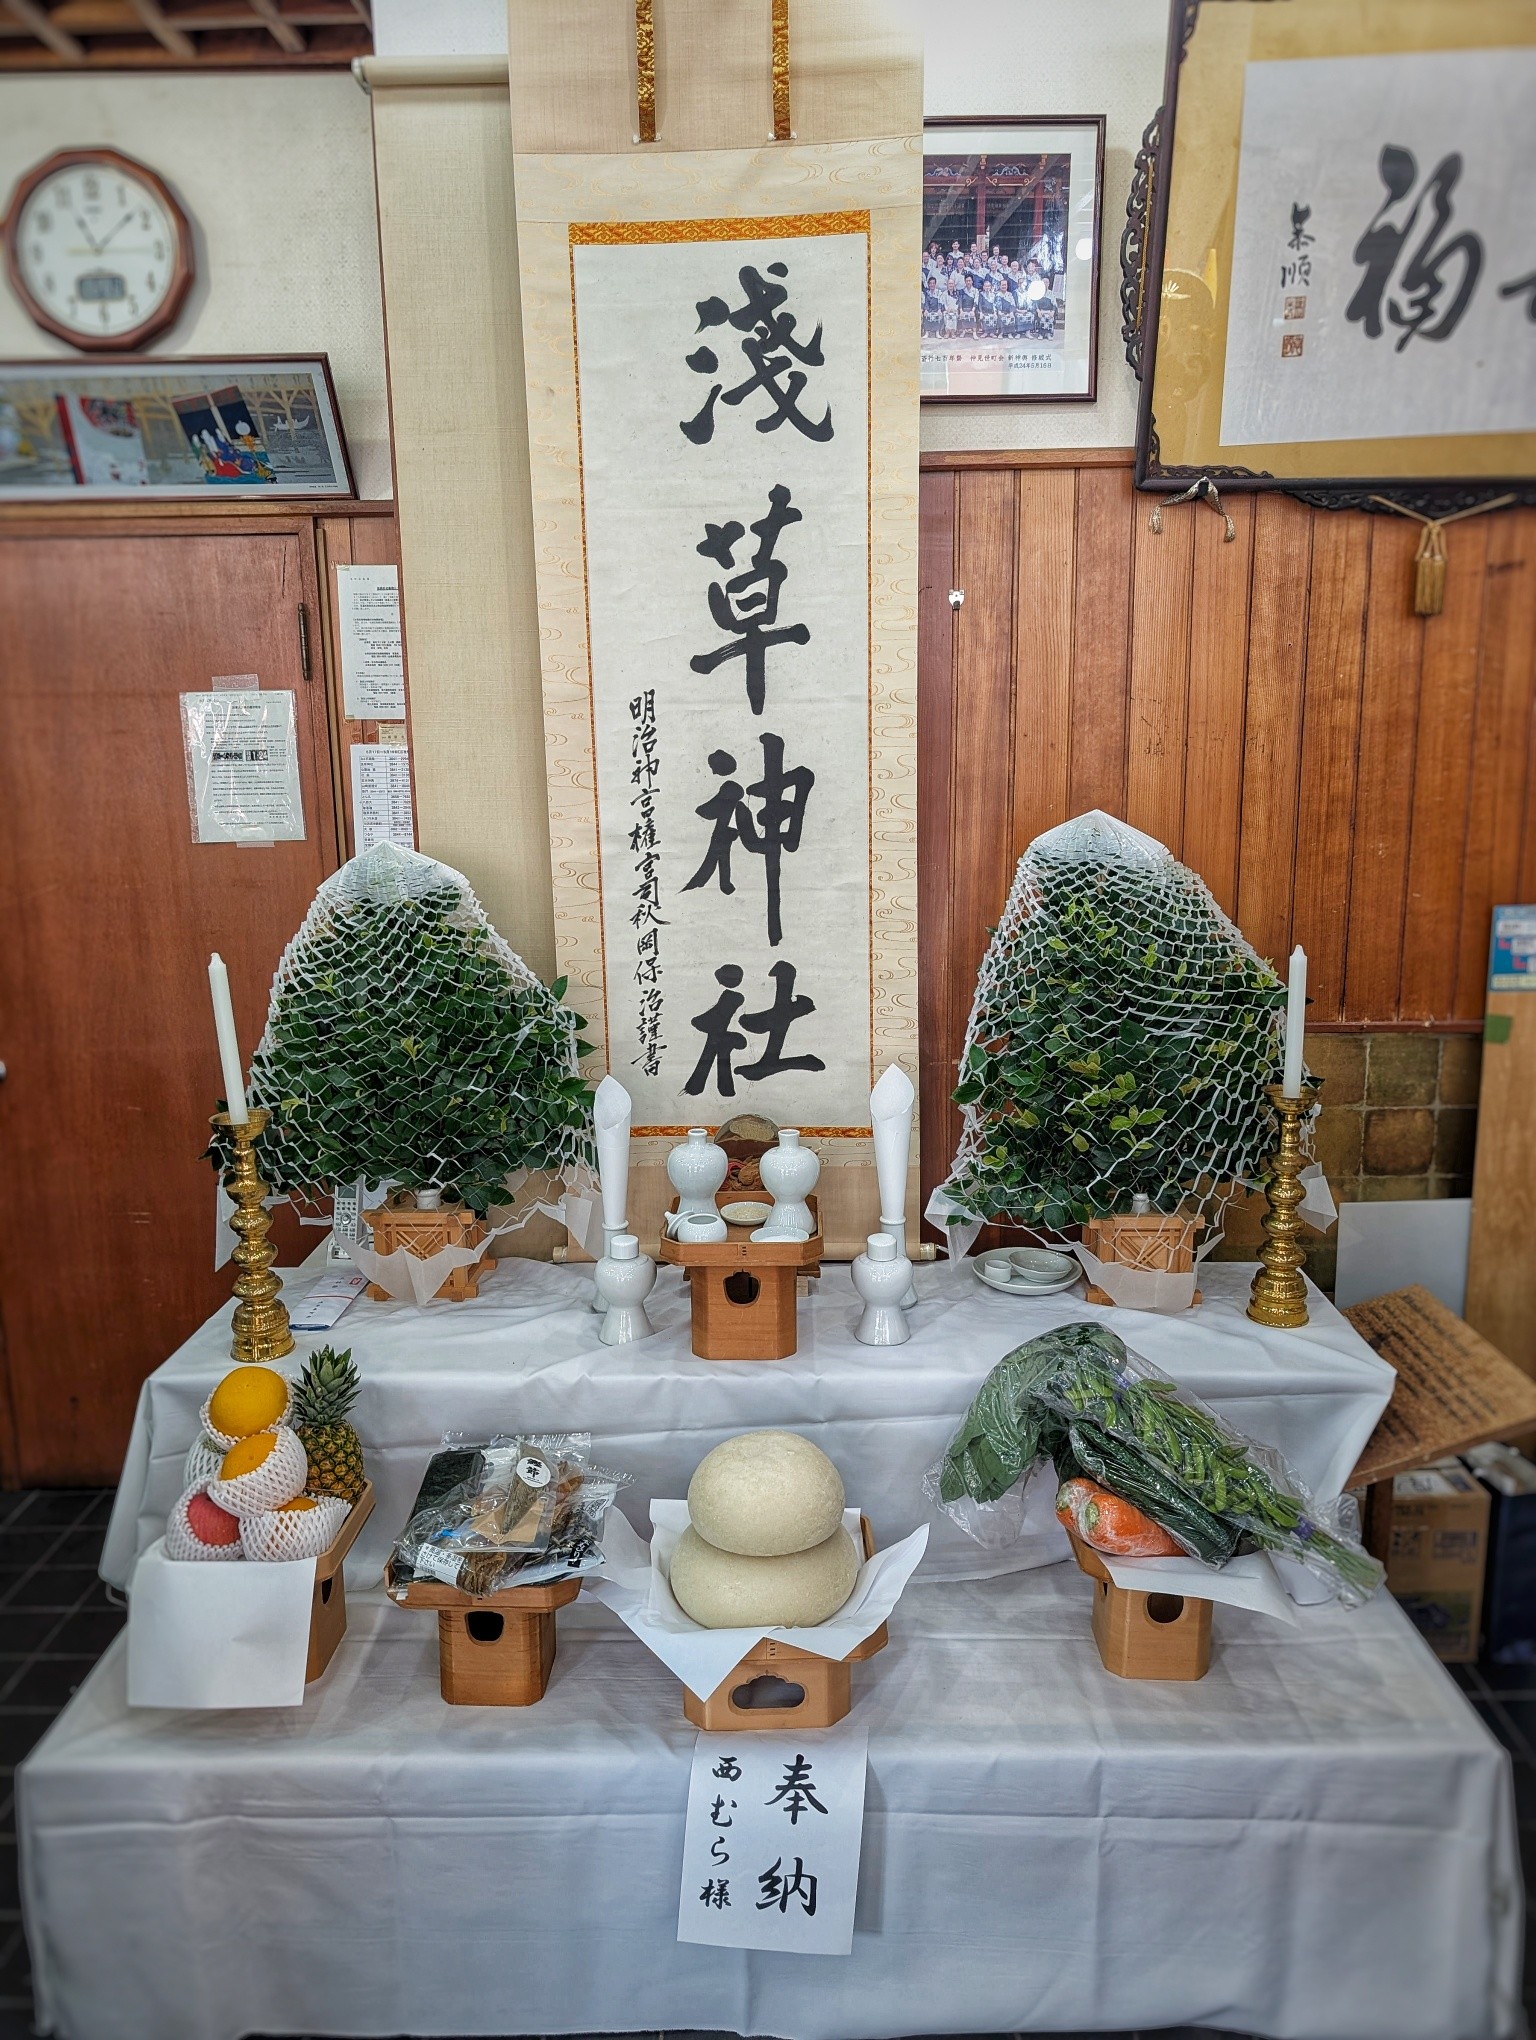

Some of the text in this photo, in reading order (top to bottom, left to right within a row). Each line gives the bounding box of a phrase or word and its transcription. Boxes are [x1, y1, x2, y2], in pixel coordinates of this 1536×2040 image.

[699, 1755, 743, 1910] 西むら様
[755, 1753, 829, 1917] 奉納
